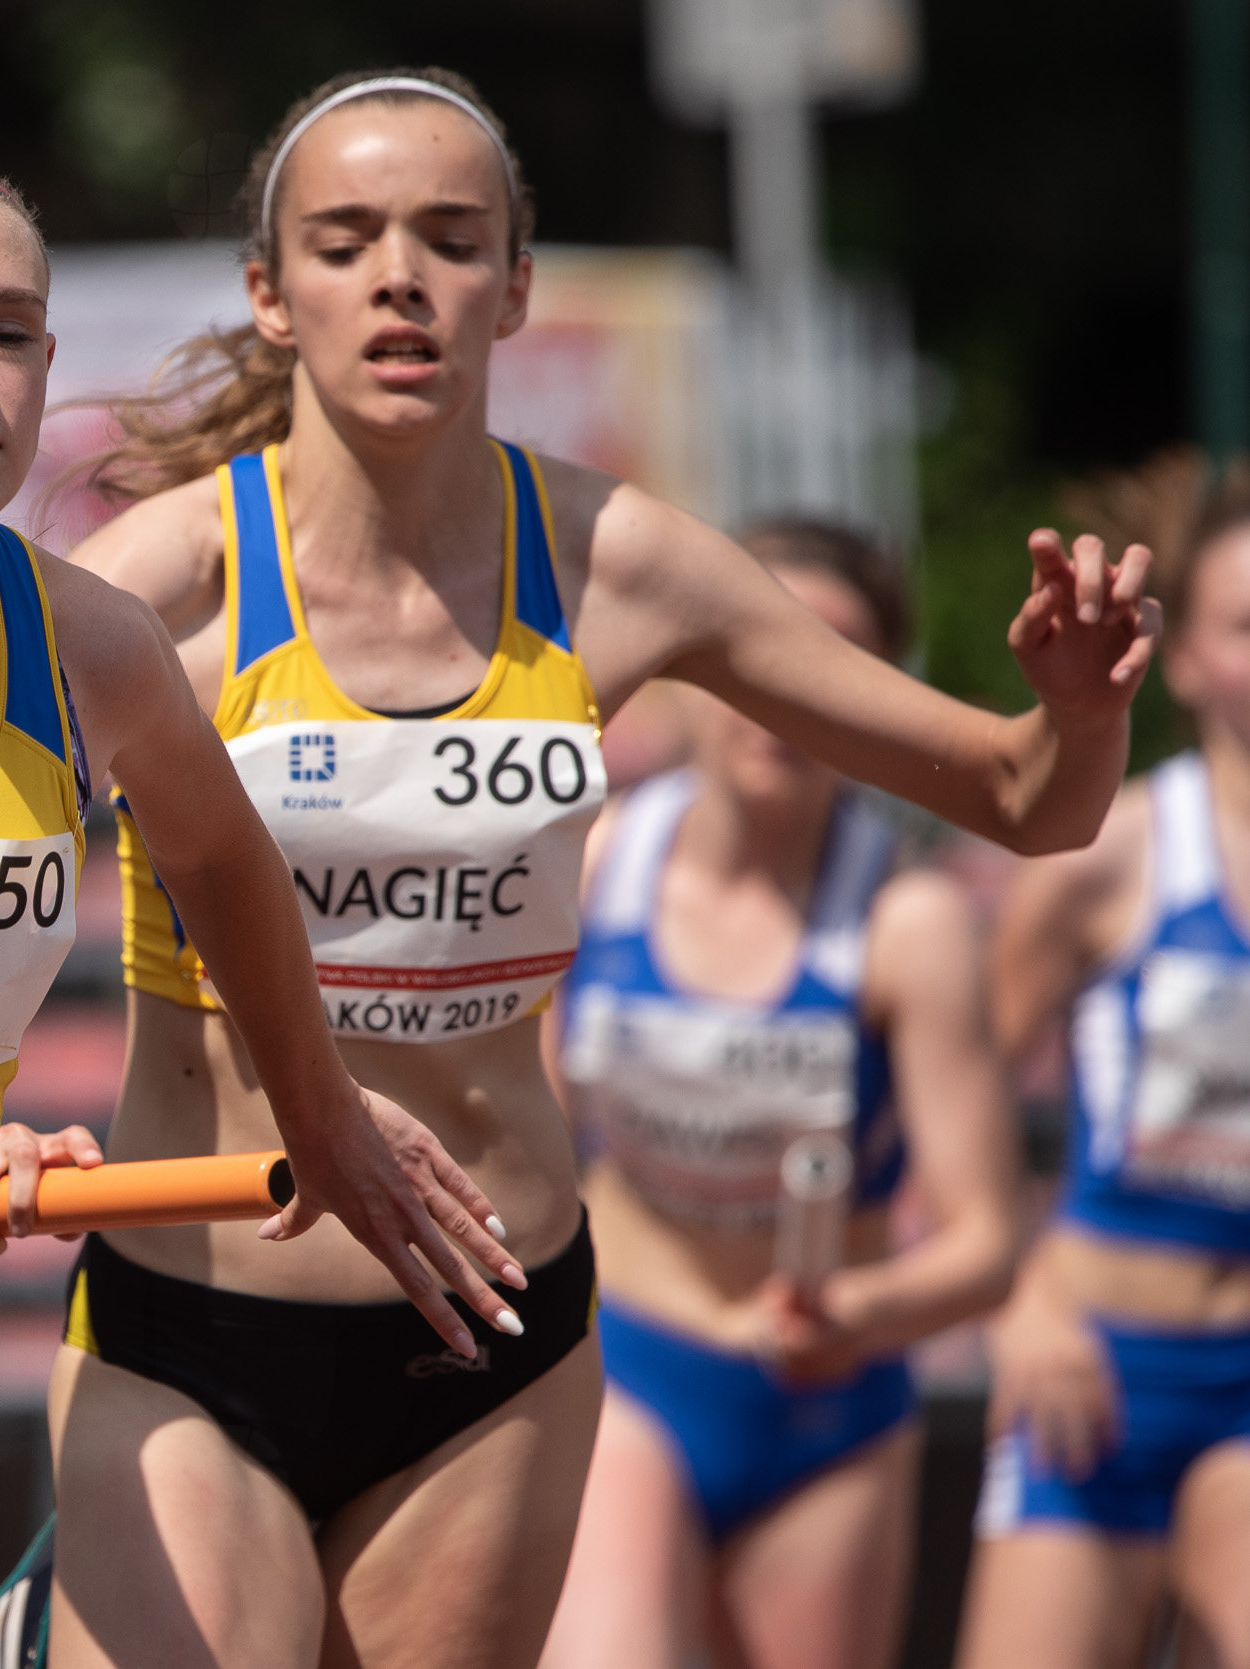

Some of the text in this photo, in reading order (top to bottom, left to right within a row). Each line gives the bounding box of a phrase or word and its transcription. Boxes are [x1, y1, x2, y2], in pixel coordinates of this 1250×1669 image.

[432, 737, 586, 805] 360
[282, 795, 342, 810] Kraków
[293, 853, 530, 932] NAGIĘĆ
[442, 992, 519, 1032] 2019
